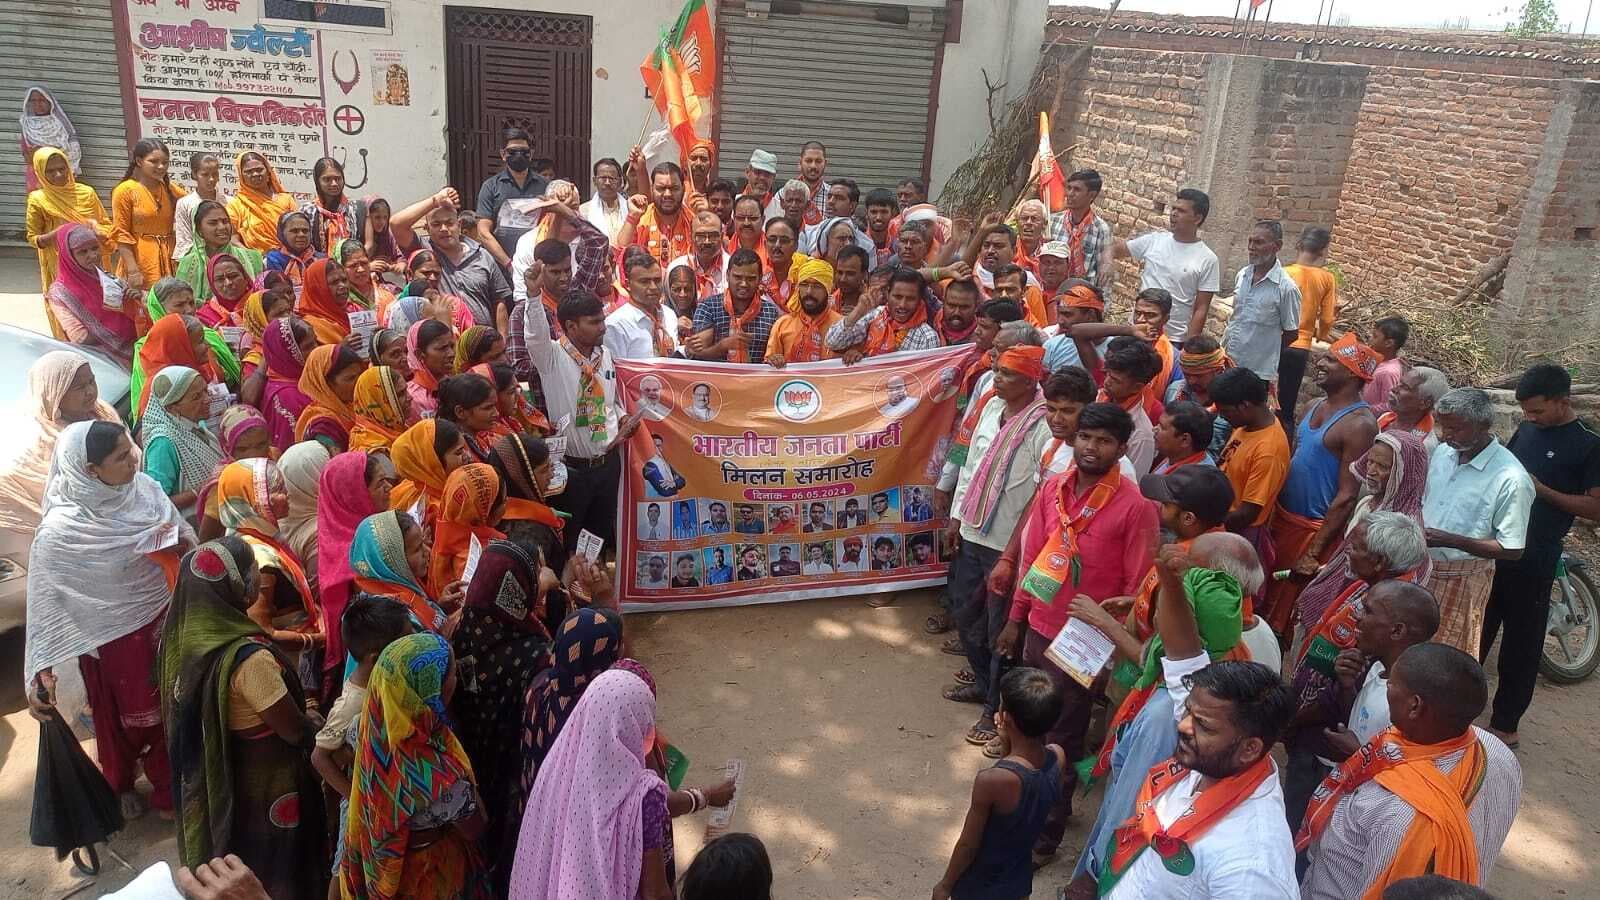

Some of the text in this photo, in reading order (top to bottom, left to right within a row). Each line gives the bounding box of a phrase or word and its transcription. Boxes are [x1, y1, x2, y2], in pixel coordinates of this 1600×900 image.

[140, 98, 210, 122] जनता
[691, 421, 903, 458] भारतीय जनता पार्टी
[720, 457, 876, 485] मिलन समारोह
[791, 486, 847, 500] 06.05.2024
